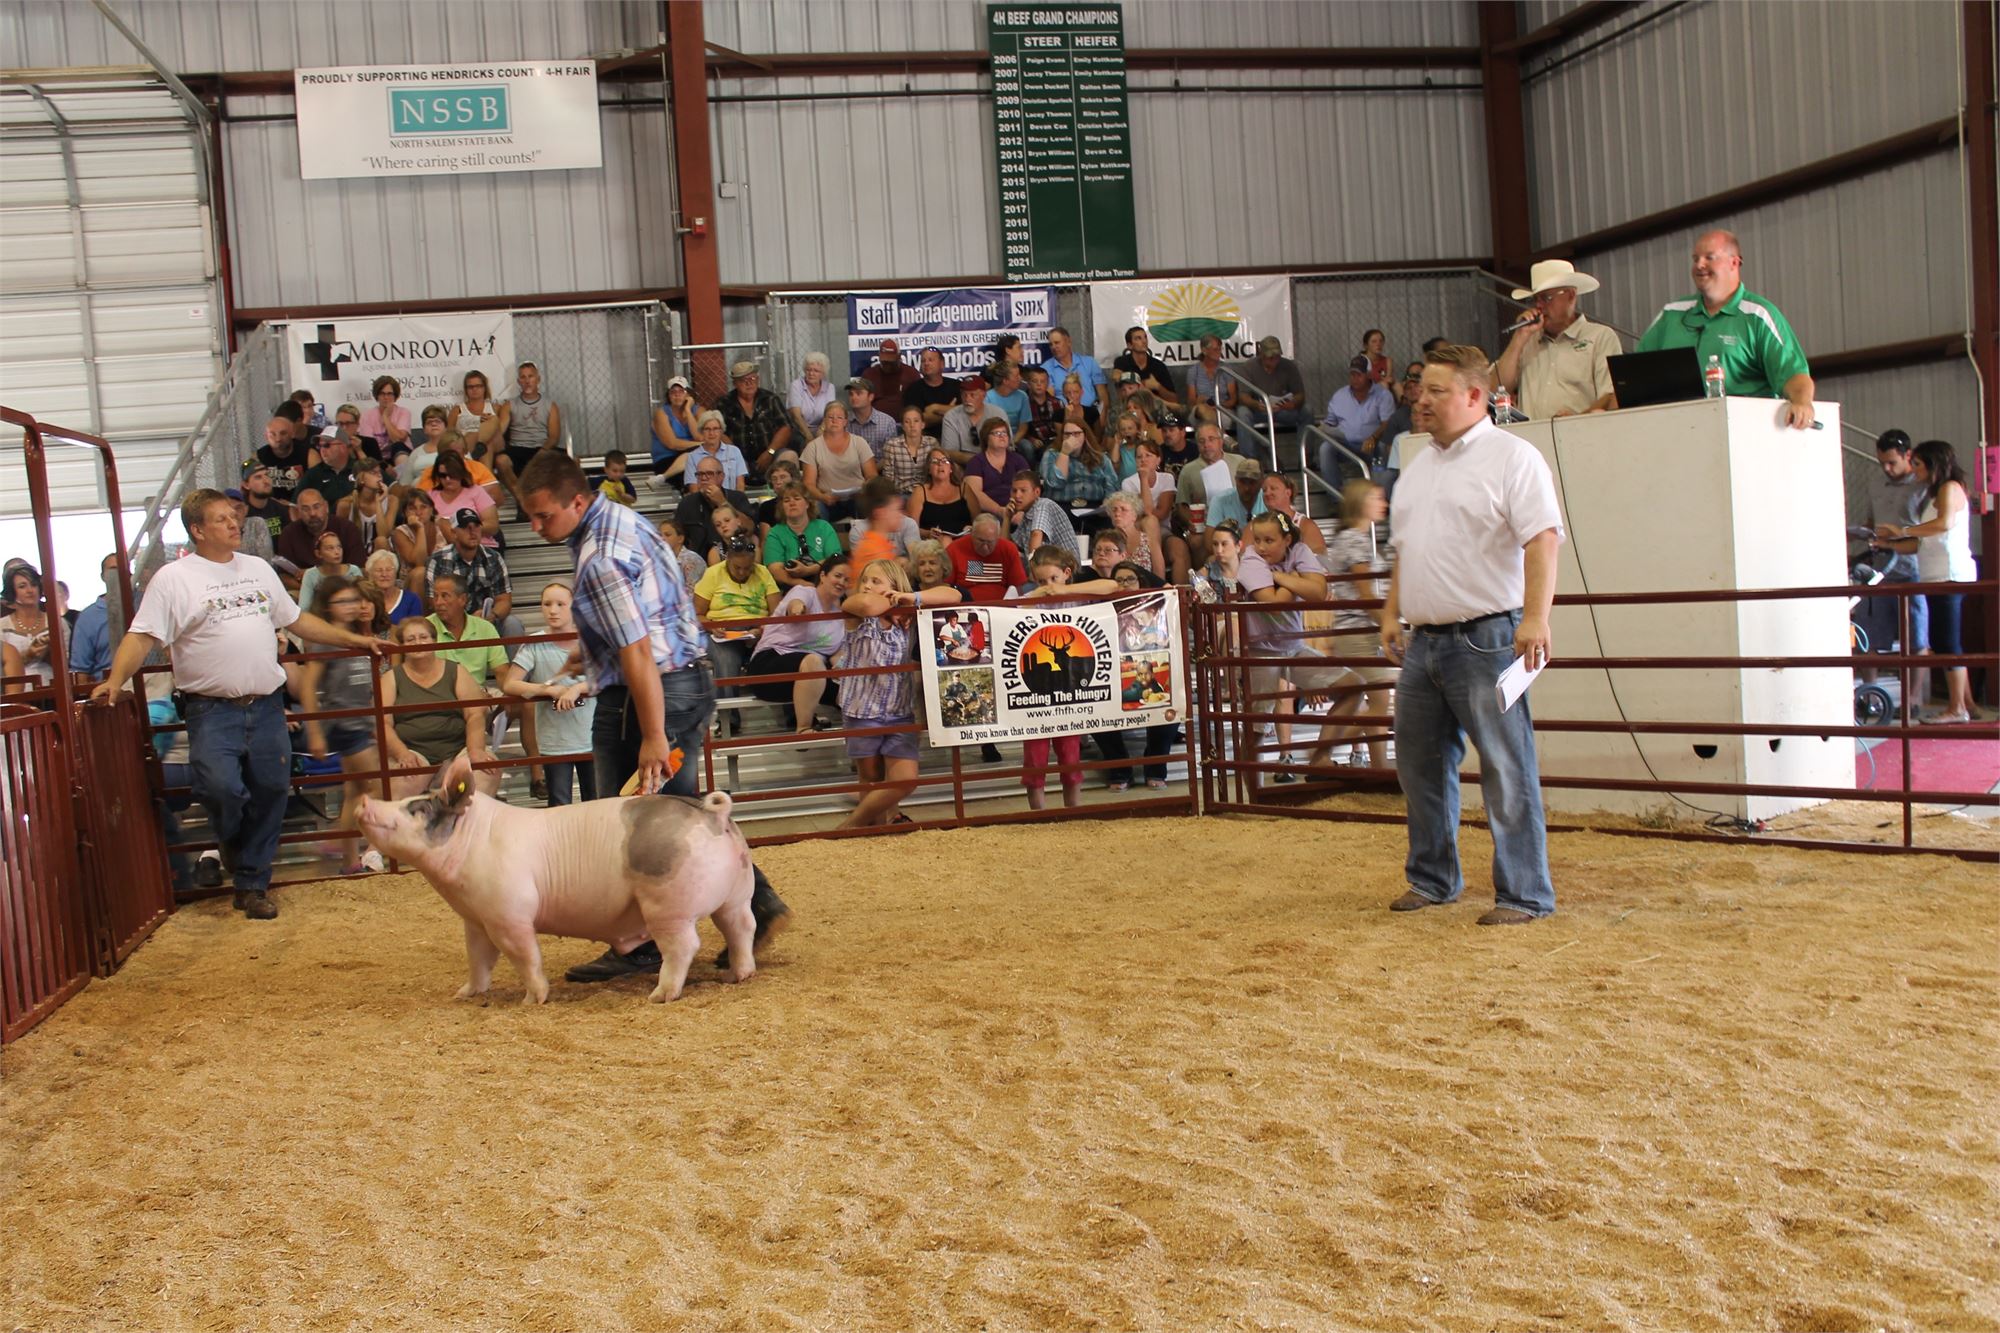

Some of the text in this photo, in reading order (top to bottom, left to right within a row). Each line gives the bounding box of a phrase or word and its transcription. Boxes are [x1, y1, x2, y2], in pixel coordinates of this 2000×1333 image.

[993, 11, 1118, 25] 4H BEEF GRAND CHAMPIONS
[1024, 36, 1117, 46] STEER HEIFER
[994, 56, 1017, 64] 2006
[302, 66, 590, 84] PROUDLY SUPPORTING HENDRICKS COUNT 4-H FAIR
[995, 69, 1018, 77] 2007
[996, 83, 1018, 91] 2008
[997, 96, 1019, 104] 2009
[400, 97, 499, 124] NSSB
[998, 110, 1020, 118] 2010
[999, 123, 1021, 132] 2011
[390, 136, 513, 149] NORTH SALEM STATE BANK
[1000, 137, 1022, 146] 2012
[1000, 151, 1023, 159] 2013
[416, 155, 458, 171] caring
[461, 152, 486, 166] still
[1001, 164, 1024, 173] 2014
[1002, 178, 1025, 186] 2015
[1003, 192, 1026, 200] 2016
[1004, 205, 1027, 214] 2017
[1005, 218, 1028, 227] 2018
[1006, 232, 1029, 240] 2019
[1007, 245, 1030, 254] 2020
[1008, 258, 1030, 267] 2021
[1008, 272, 1023, 282] Sign
[1023, 271, 1051, 280] Donated
[1059, 270, 1085, 279] Memory
[1087, 270, 1094, 278] of
[1113, 268, 1135, 277] Turner
[1015, 299, 1044, 317] smx
[861, 300, 999, 328] staff management
[858, 336, 910, 348] IMMETE
[912, 334, 958, 346] OPENINGS
[960, 333, 970, 343] IN
[973, 331, 1039, 344] GREENTLE,
[350, 338, 481, 361] MONROVIA
[1001, 613, 1112, 691] FARMERS AND HUNTERS
[1009, 688, 1110, 706] Feeding The Hungry
[1027, 705, 1094, 719] www.fhfh.org
[960, 714, 1151, 741] Did you know that one deer can feed 200 hungry people?
